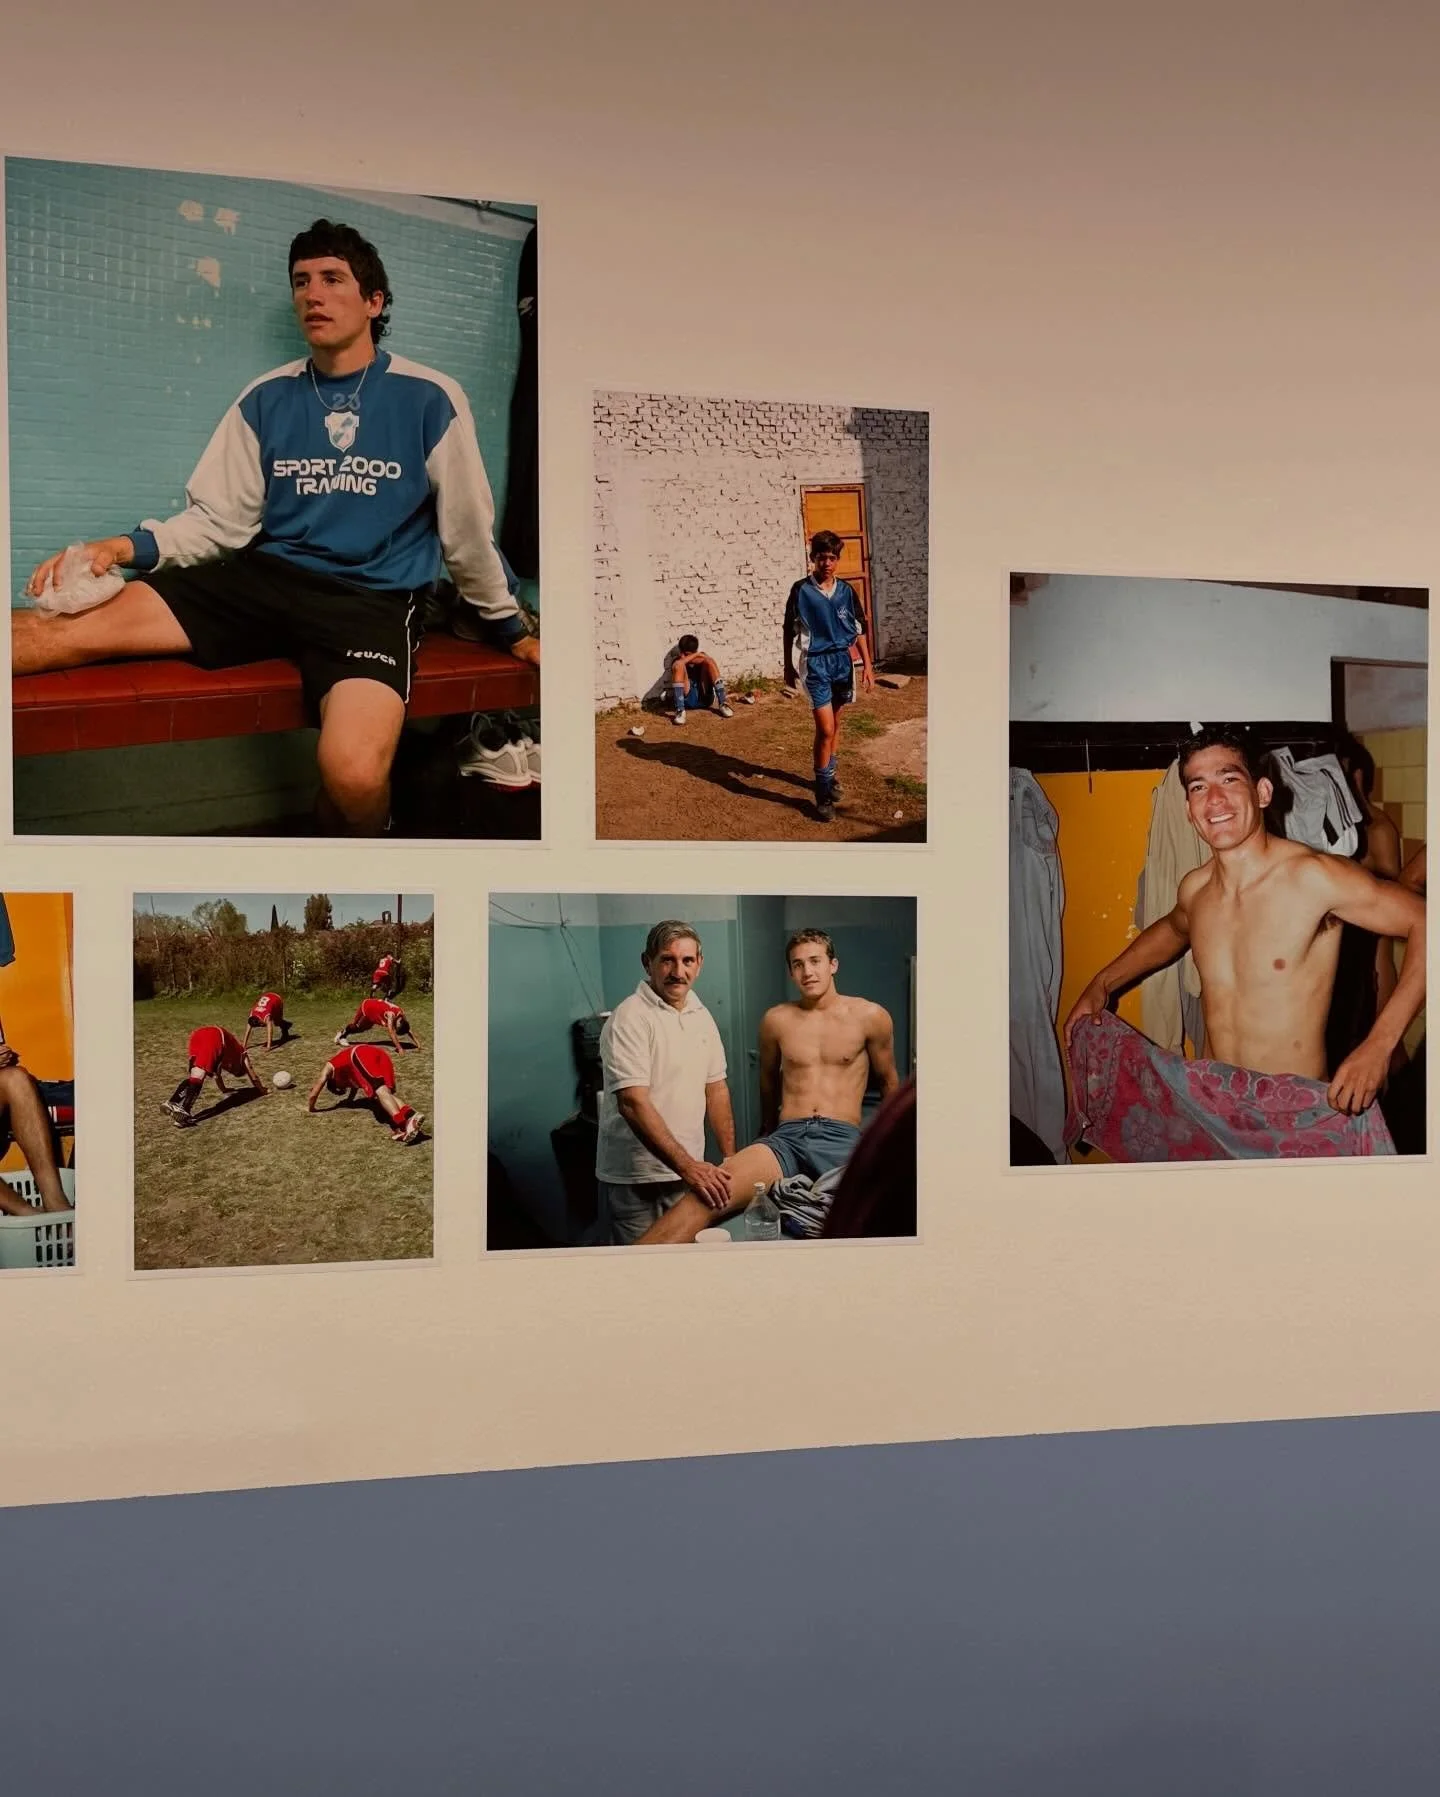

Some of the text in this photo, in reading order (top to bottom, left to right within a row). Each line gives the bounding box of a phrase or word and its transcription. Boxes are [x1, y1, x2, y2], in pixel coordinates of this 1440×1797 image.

[273, 455, 402, 480] SPORT 2000
[296, 473, 377, 496] TRANING
